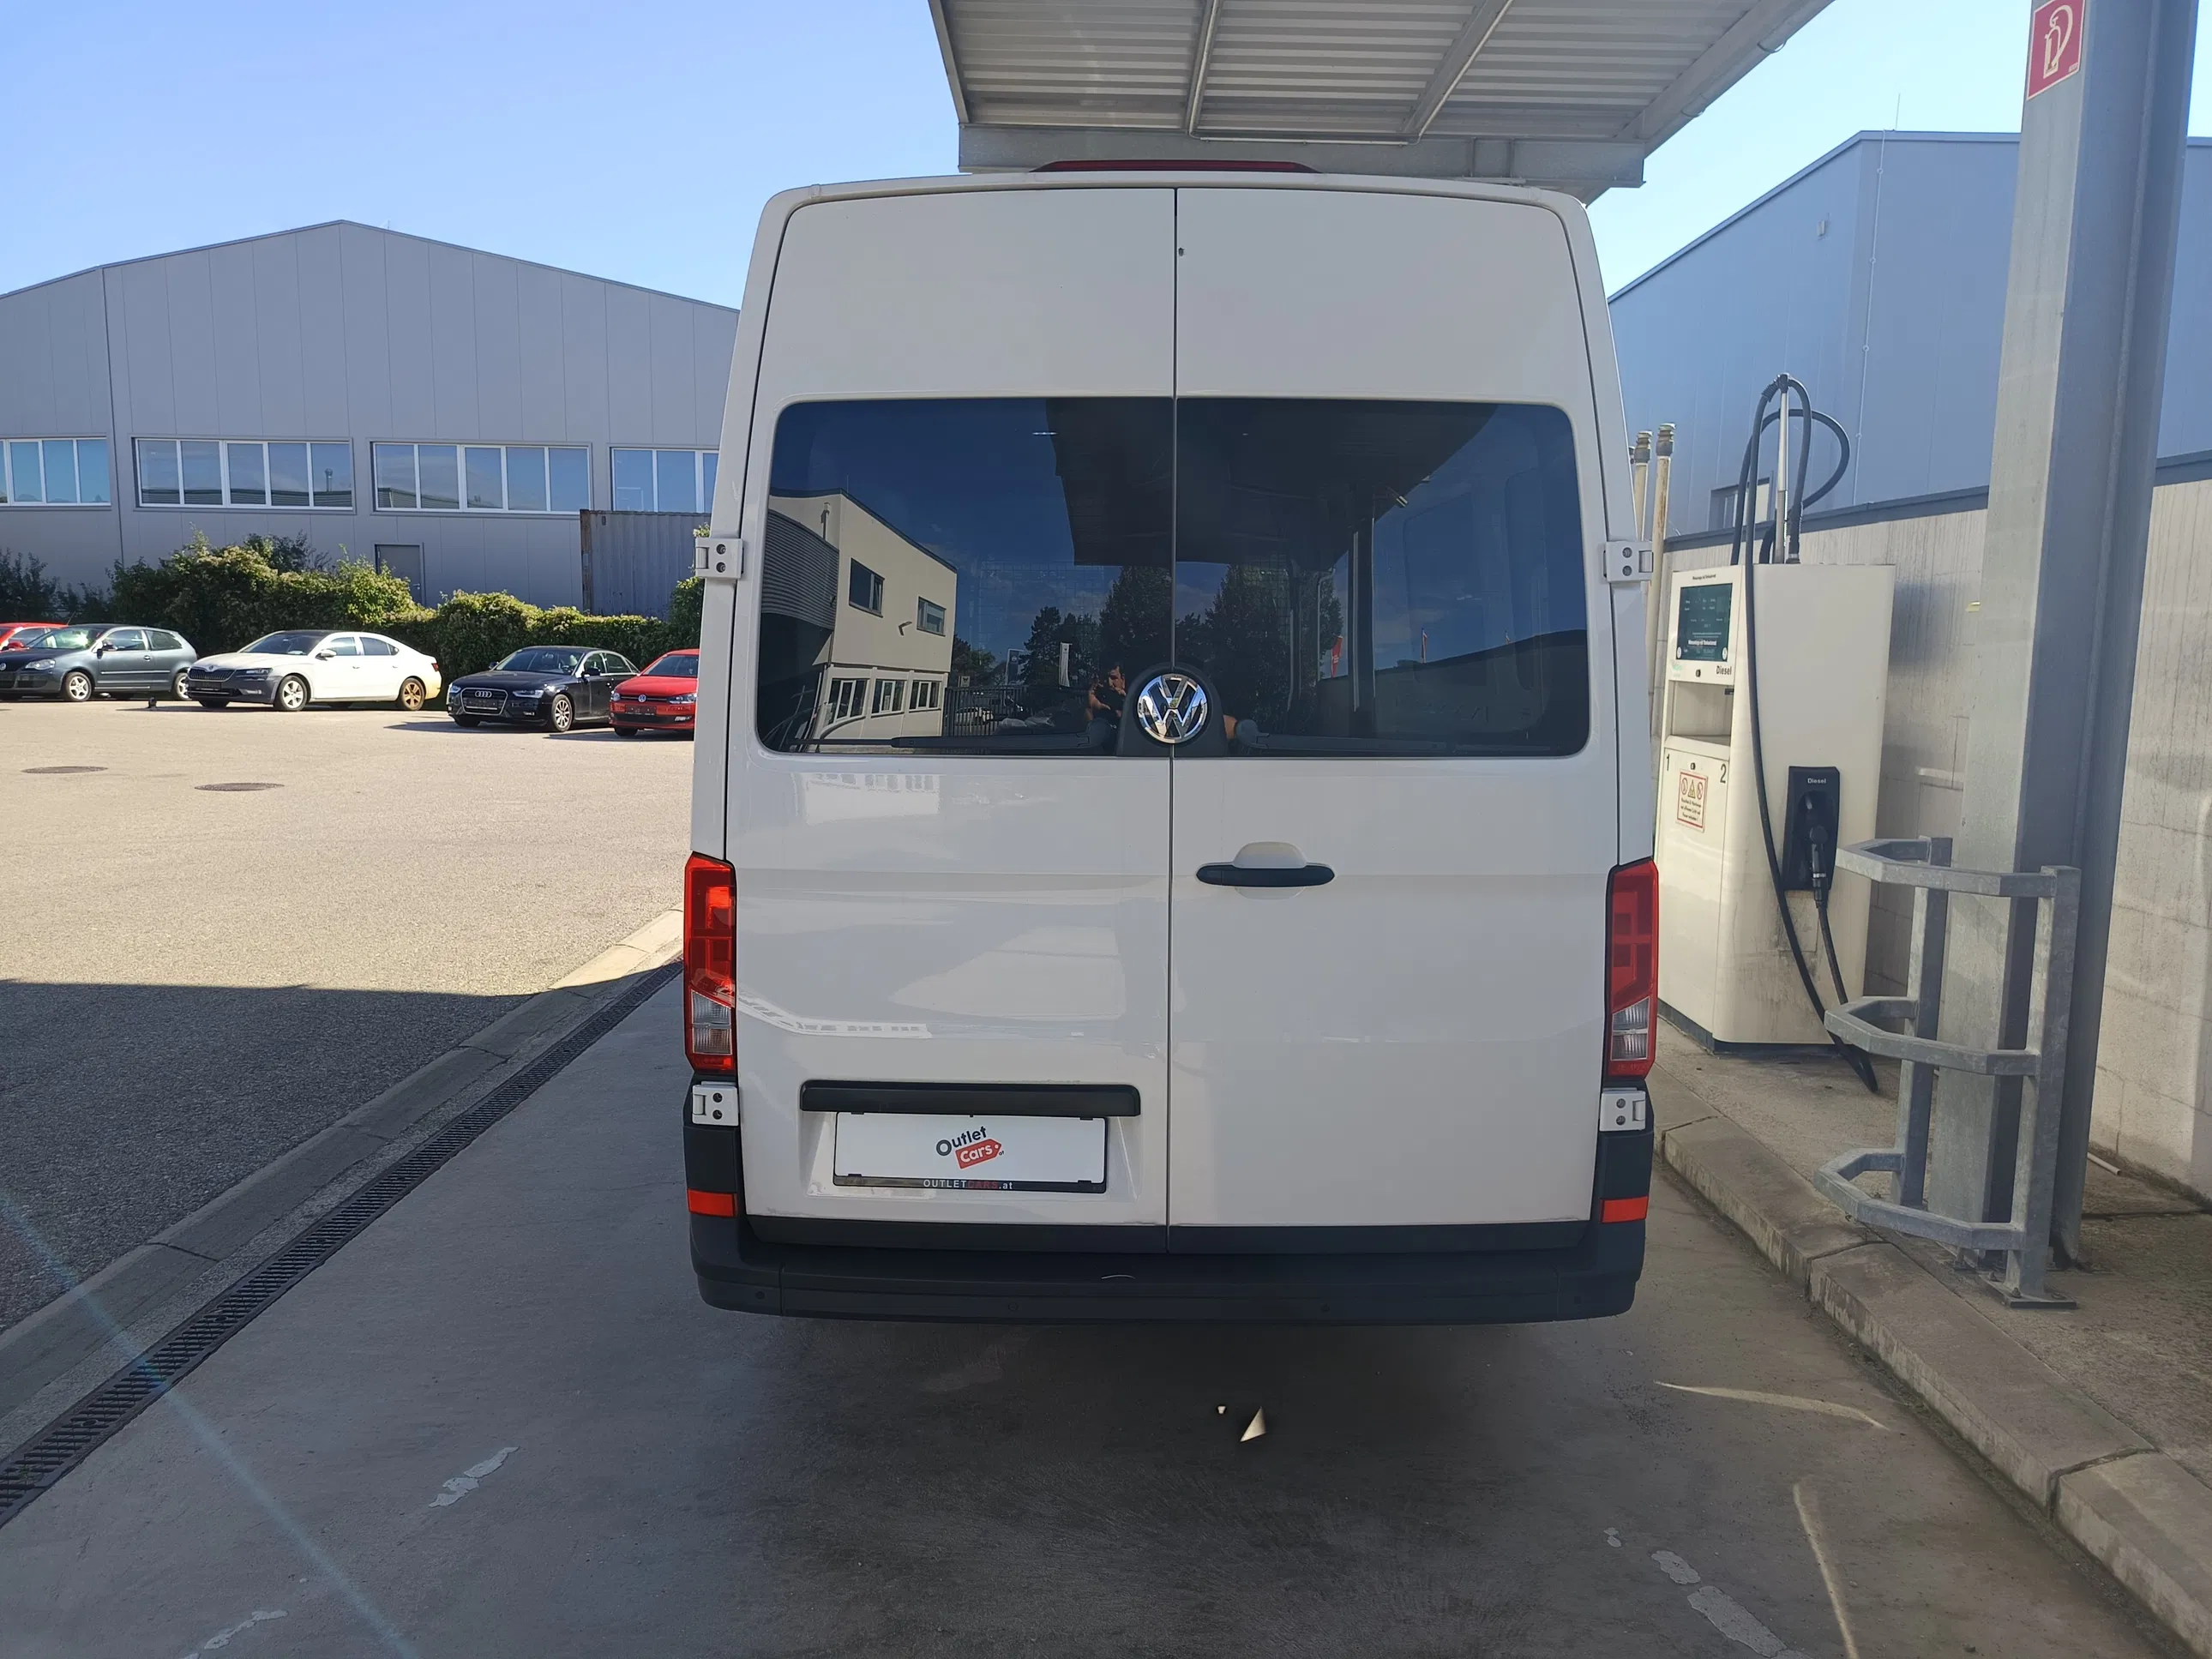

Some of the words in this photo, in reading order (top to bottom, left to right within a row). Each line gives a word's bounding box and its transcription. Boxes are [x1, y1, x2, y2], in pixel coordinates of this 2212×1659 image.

[1716, 665, 1732, 676] Diesel
[1138, 673, 1207, 743] VW
[1666, 754, 1670, 772] 1
[1720, 763, 1727, 784] 2
[936, 1126, 987, 1156] Outlet
[959, 1144, 993, 1163] Cars
[923, 1179, 1013, 1190] OUTLETCARS.at
